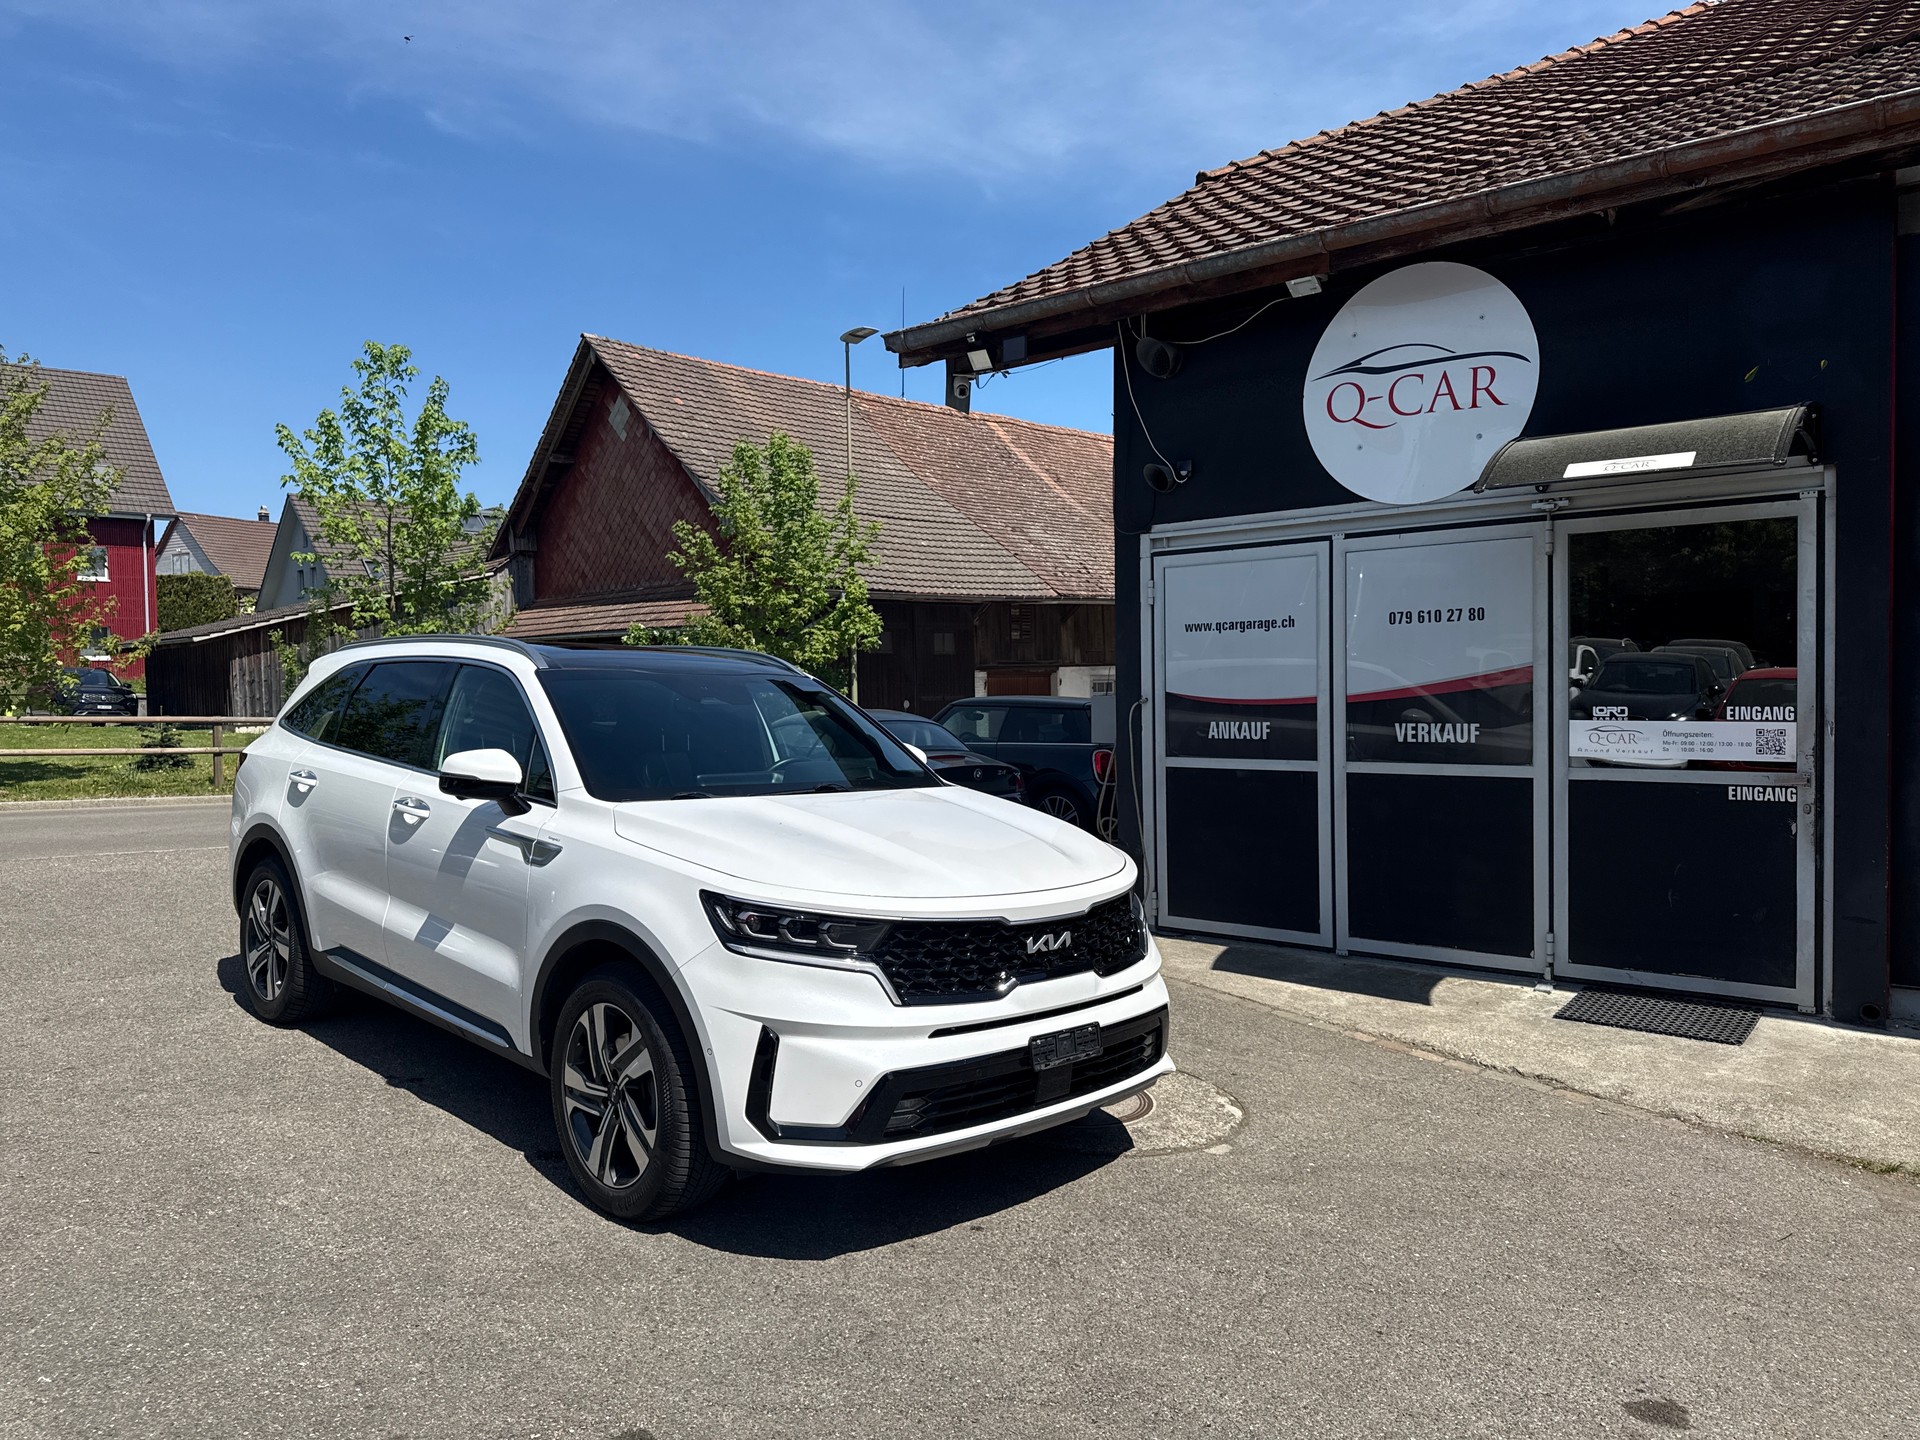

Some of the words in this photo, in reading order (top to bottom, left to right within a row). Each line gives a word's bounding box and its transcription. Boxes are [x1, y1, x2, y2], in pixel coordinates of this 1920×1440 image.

[1326, 365, 1509, 429] Q-CAR
[1603, 461, 1650, 471] Q-CAR
[1184, 615, 1295, 634] www.qcargarage.ch
[1389, 611, 1412, 625] 079
[1417, 609, 1442, 624] 610
[1446, 608, 1463, 622] 27
[1468, 607, 1485, 621] 80
[1726, 706, 1795, 721] EINGANG
[1208, 721, 1271, 740] ANKAUF
[1395, 722, 1480, 744] VERKAUF
[1588, 732, 1639, 746] Q-CAR
[1662, 729, 1714, 739] Öffnungszeiten:
[1728, 786, 1797, 803] EINGANG
